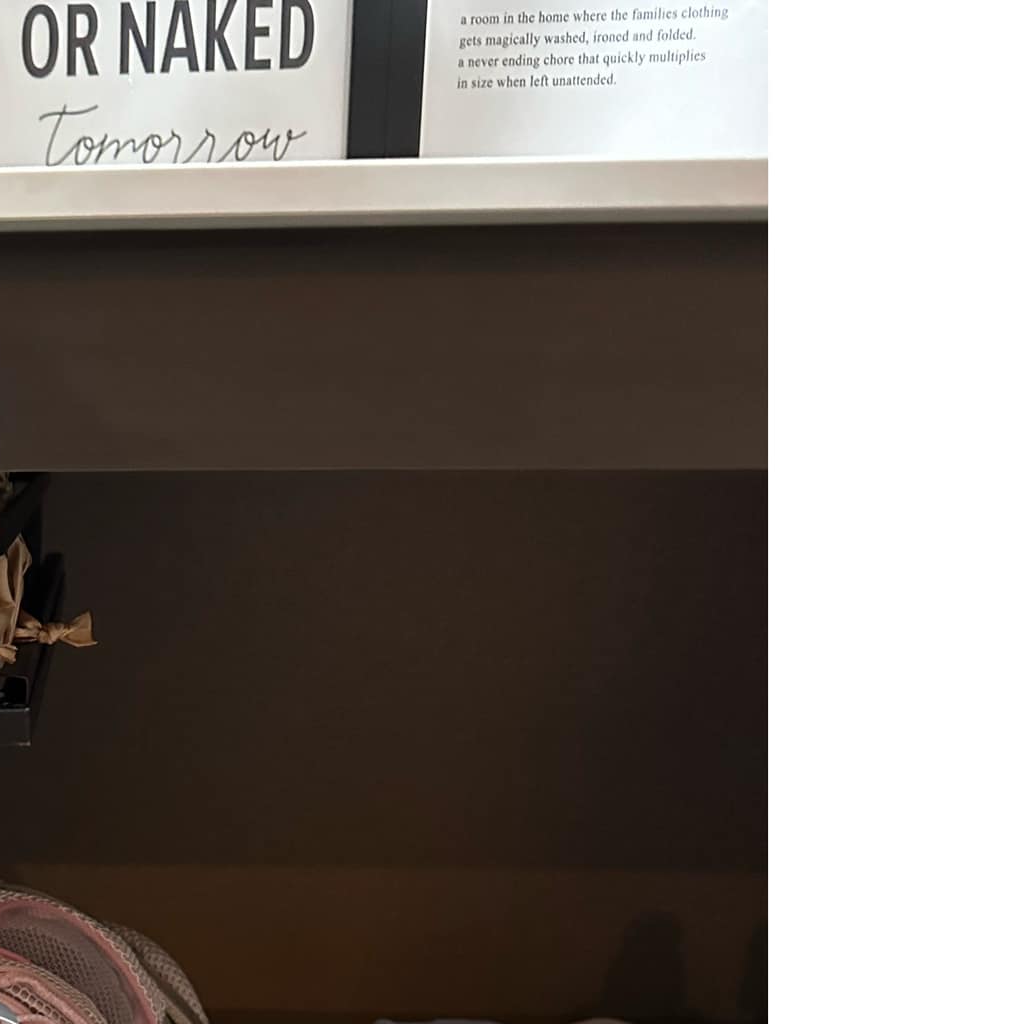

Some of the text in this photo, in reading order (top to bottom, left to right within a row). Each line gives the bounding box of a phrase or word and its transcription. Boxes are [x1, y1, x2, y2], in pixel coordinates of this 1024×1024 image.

[460, 6, 729, 25] a room in the home where the families clothing
[21, 0, 316, 78] OR NAKED
[458, 28, 697, 49] gets magically washed, ironed and folded.
[457, 49, 707, 70] a never ending chore that quickly multiplies
[457, 73, 617, 90] in size when left unattended.
